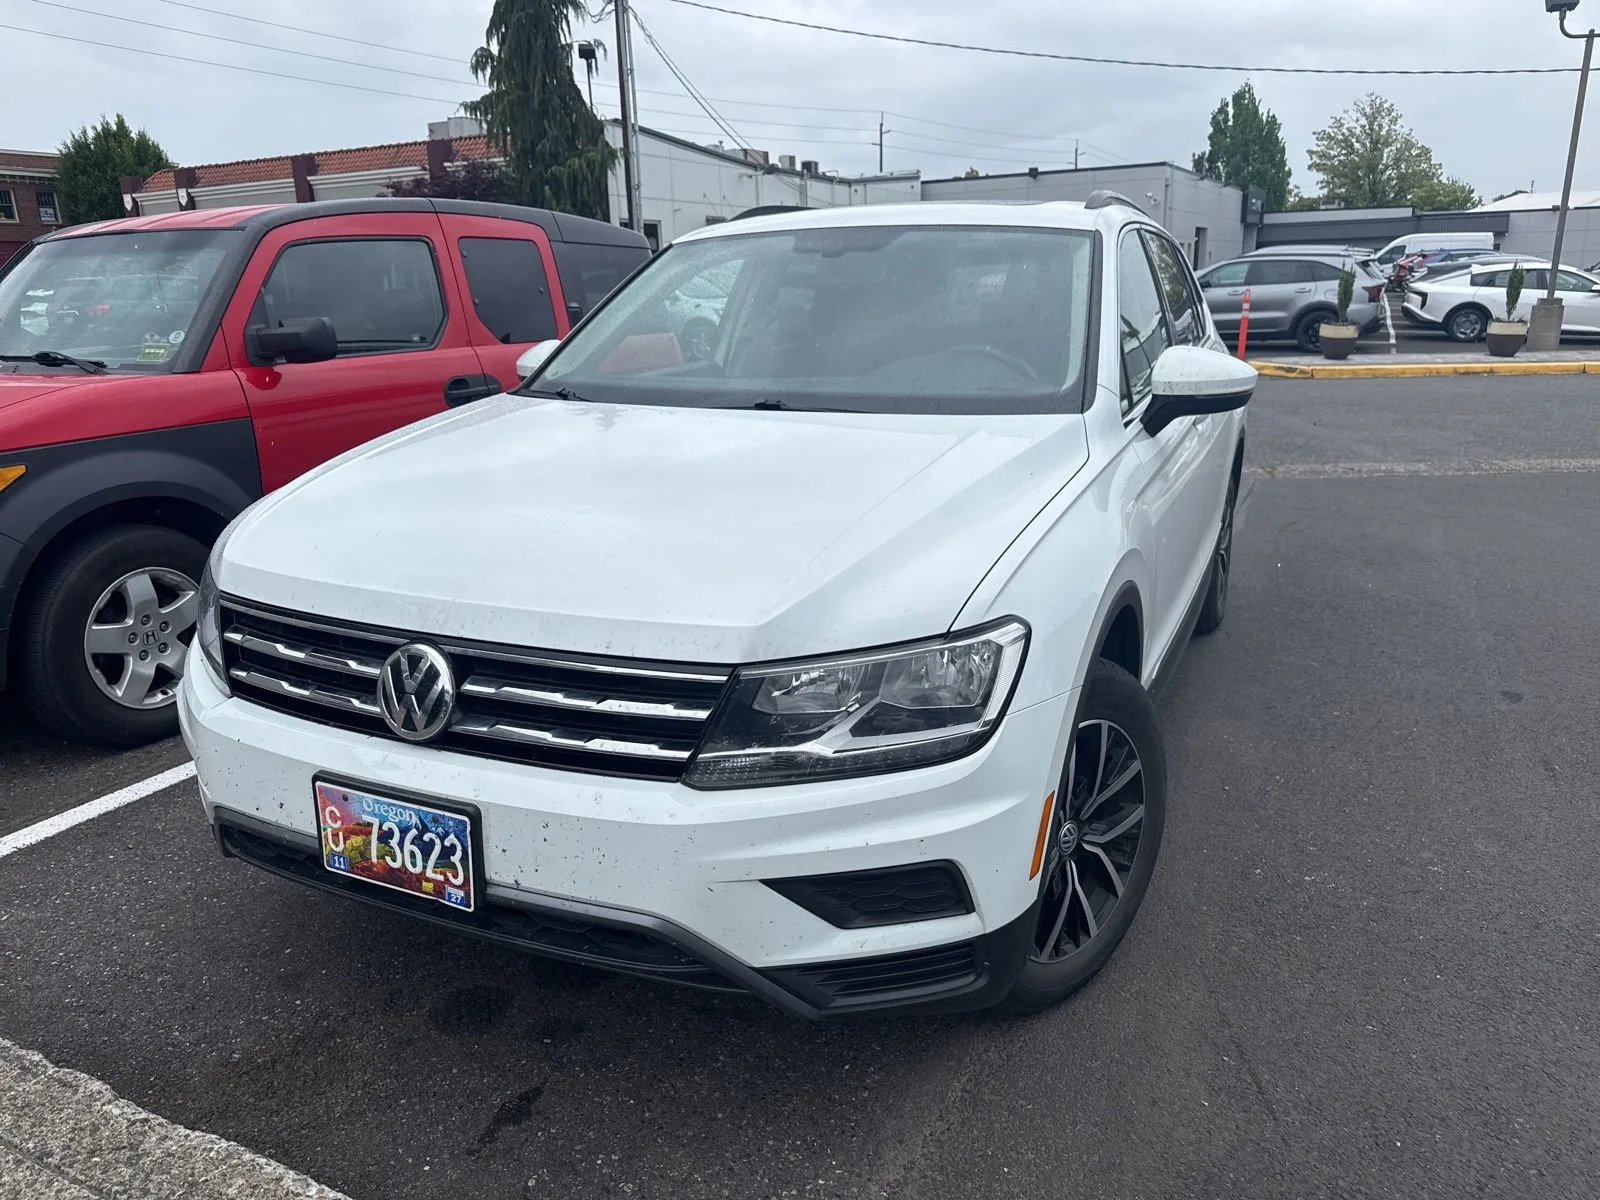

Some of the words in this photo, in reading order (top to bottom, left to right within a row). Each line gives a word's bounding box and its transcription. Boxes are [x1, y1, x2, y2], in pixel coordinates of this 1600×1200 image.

[362, 798, 416, 823] Oregon
[361, 814, 465, 886] 73623
[333, 855, 346, 869] 11
[450, 893, 462, 904] 27
